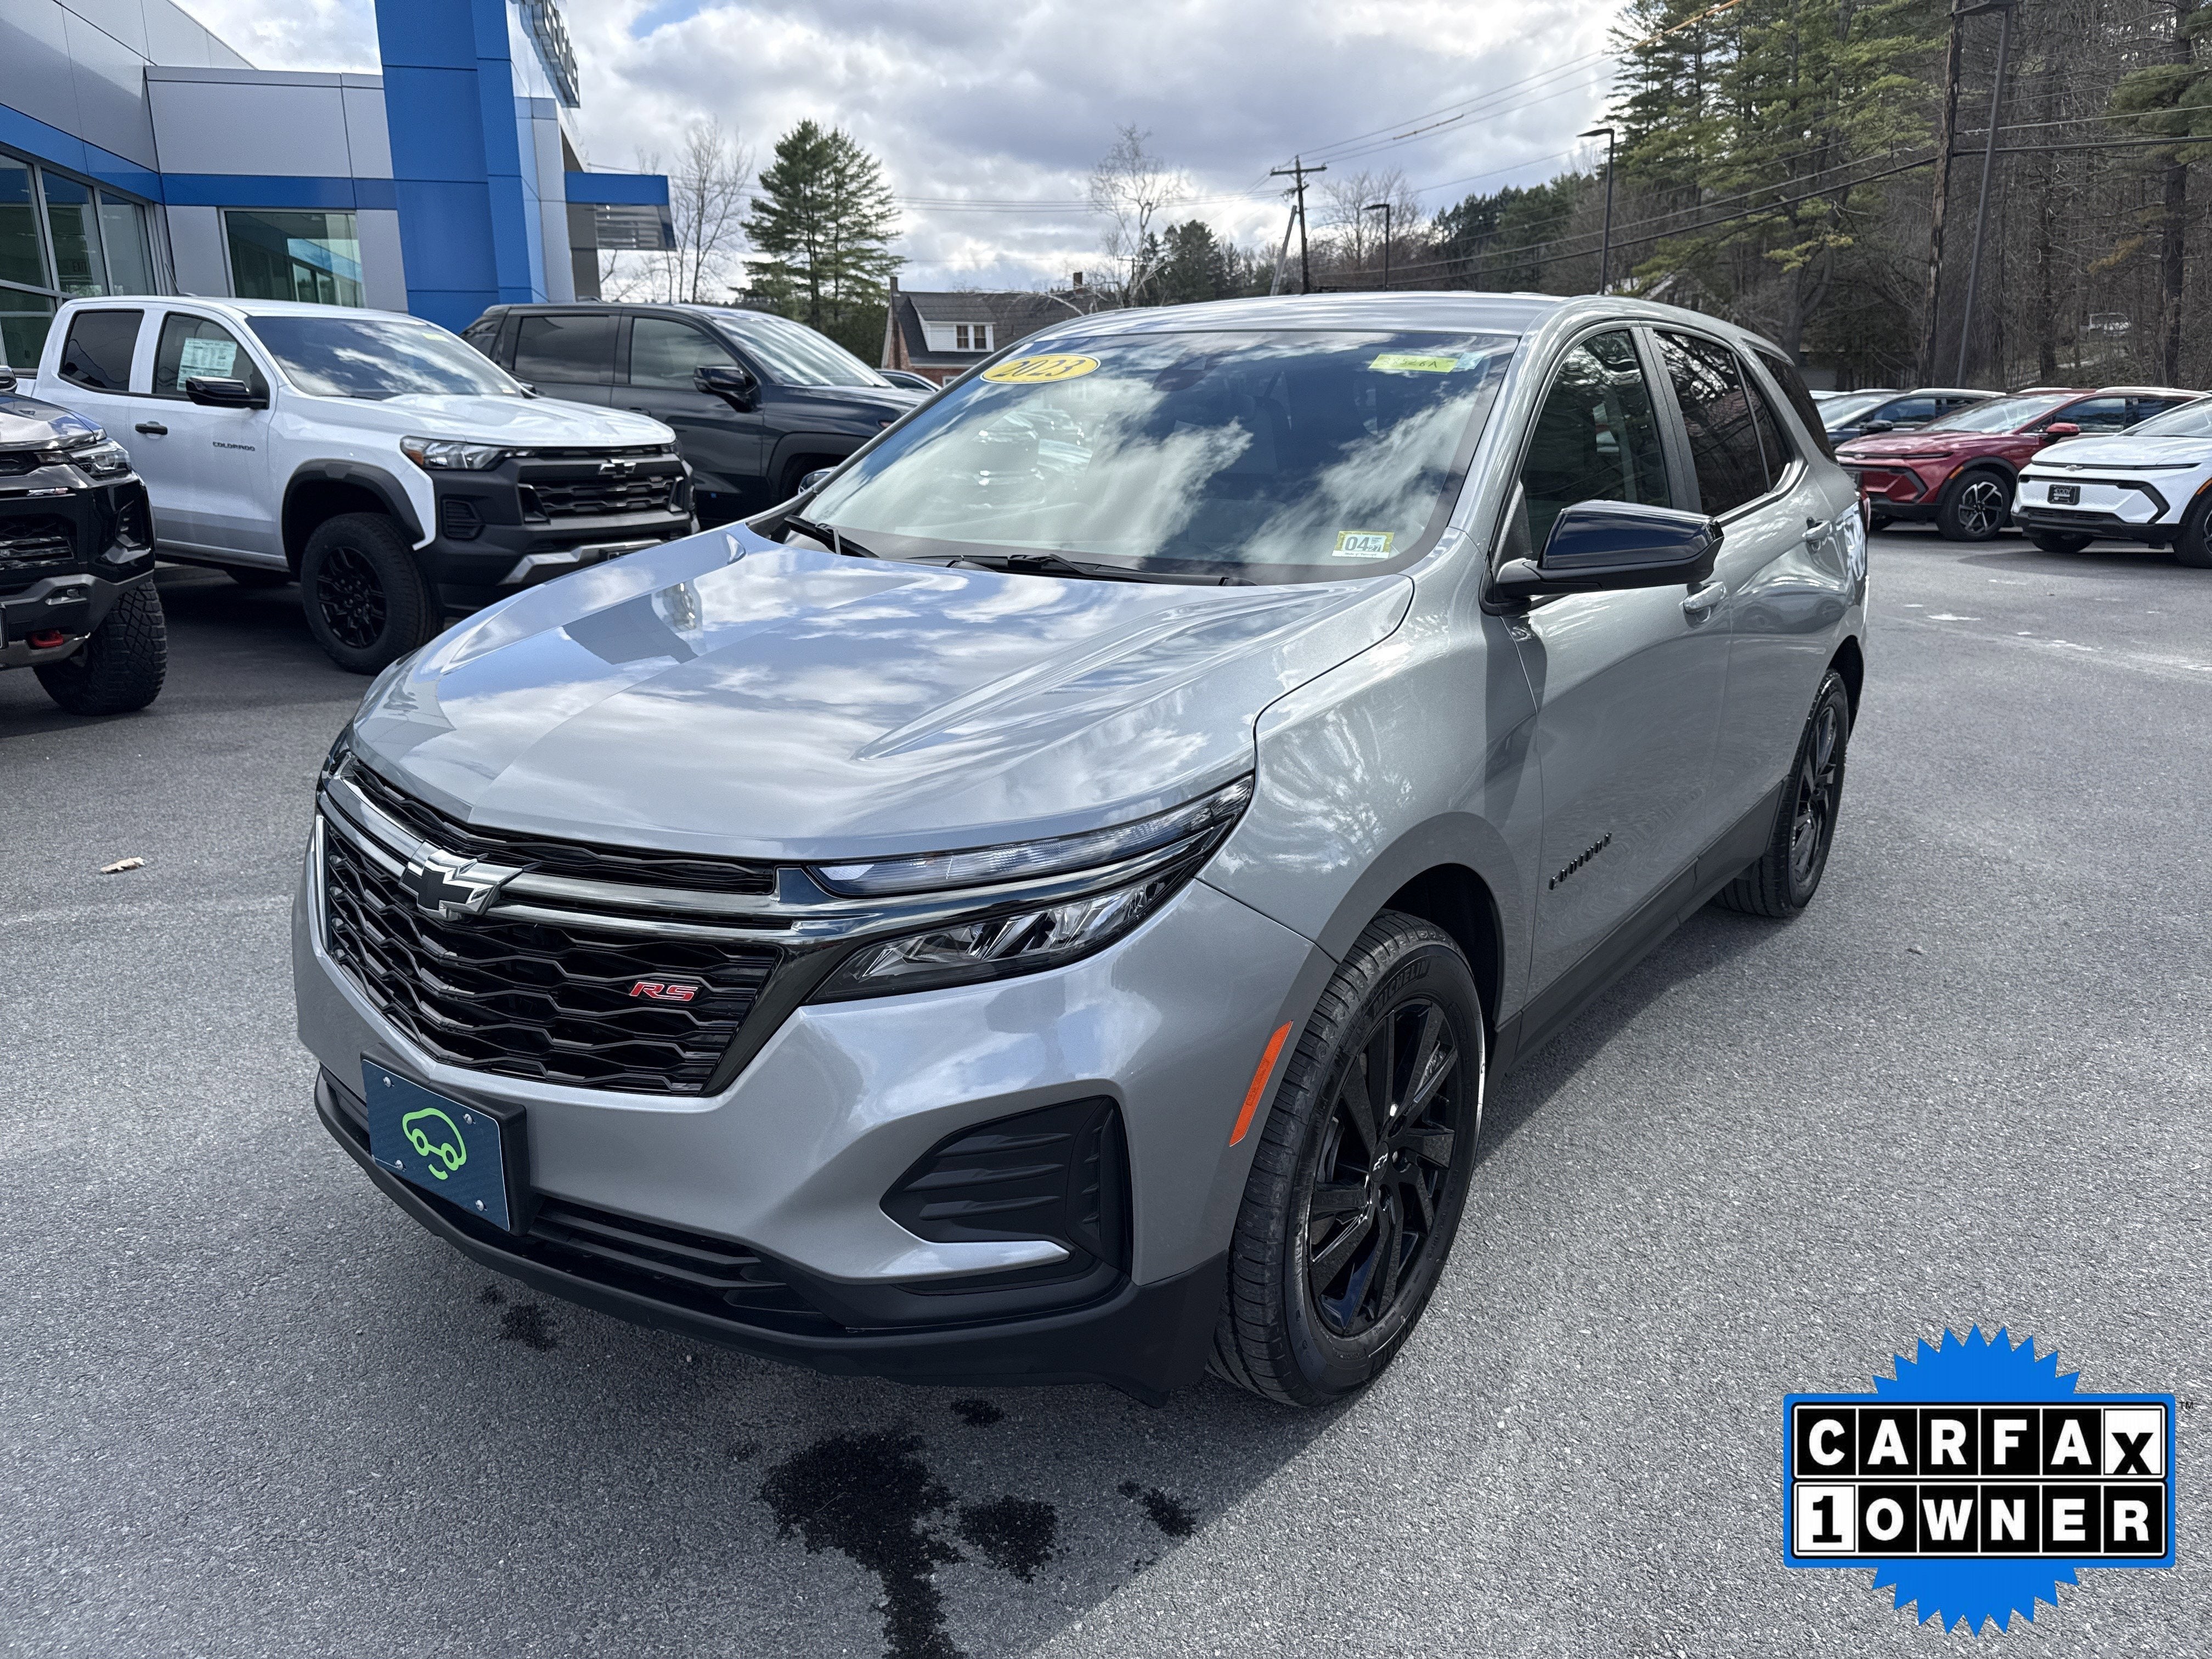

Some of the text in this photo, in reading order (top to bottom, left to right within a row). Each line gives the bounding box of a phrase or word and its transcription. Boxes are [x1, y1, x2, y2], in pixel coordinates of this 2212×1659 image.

[990, 359, 1086, 378] 2023
[1345, 536, 1370, 551] 04
[629, 981, 698, 1002] RS
[1373, 960, 1428, 1018] MICHELIN
